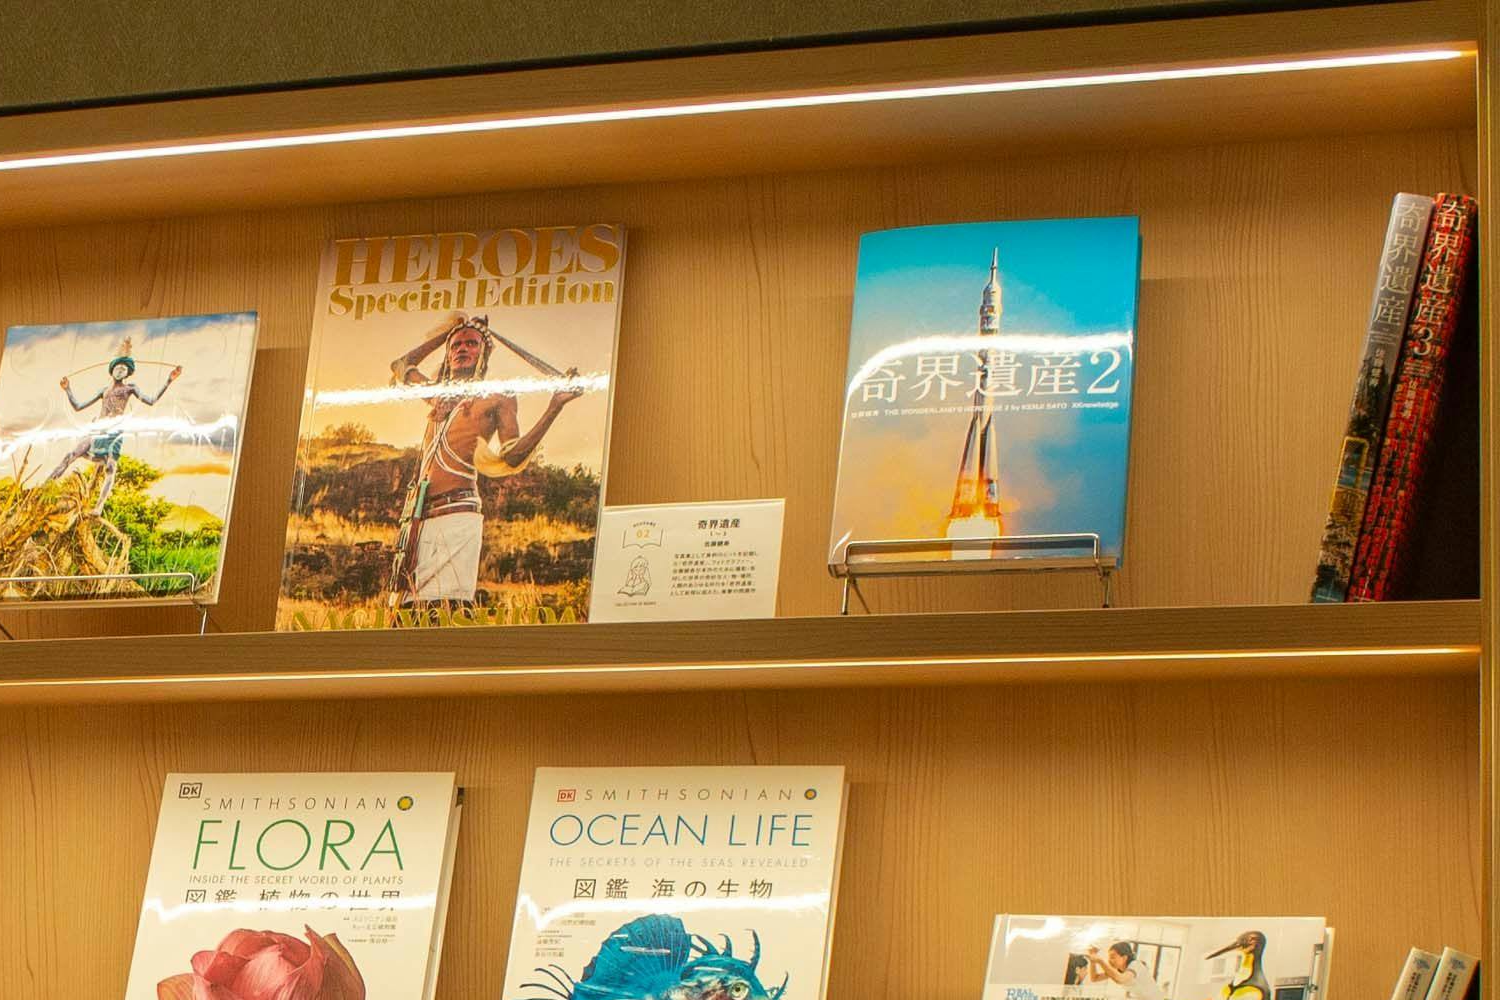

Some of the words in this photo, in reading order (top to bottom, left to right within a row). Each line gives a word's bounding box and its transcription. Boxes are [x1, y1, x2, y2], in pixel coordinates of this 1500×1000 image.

[333, 224, 621, 287] HEROES
[1372, 201, 1426, 327] 奇界遺産
[328, 279, 467, 320] Special
[474, 275, 614, 308] Edition
[698, 518, 741, 530] 奇界遺産
[636, 530, 650, 539] 02
[584, 788, 793, 800] SMITHSONIAN
[203, 796, 388, 811] SMITHSONIAN
[550, 814, 708, 846] OCEAN
[729, 814, 813, 846] LIFE
[193, 818, 404, 871] FLORA
[549, 857, 572, 868] THE
[580, 857, 636, 868] SECRETS
[644, 857, 661, 868] OF
[670, 857, 693, 868] THE
[701, 857, 733, 868] SEAS
[741, 857, 809, 868] REVEALED
[189, 875, 227, 884] INSIDE
[230, 875, 250, 884] THE
[254, 875, 294, 885] SECRET
[298, 875, 338, 885] WORLD
[343, 875, 358, 885] OF
[362, 875, 404, 885] PLANTS
[574, 878, 628, 899] 図鑑
[652, 878, 773, 899] 海の生物
